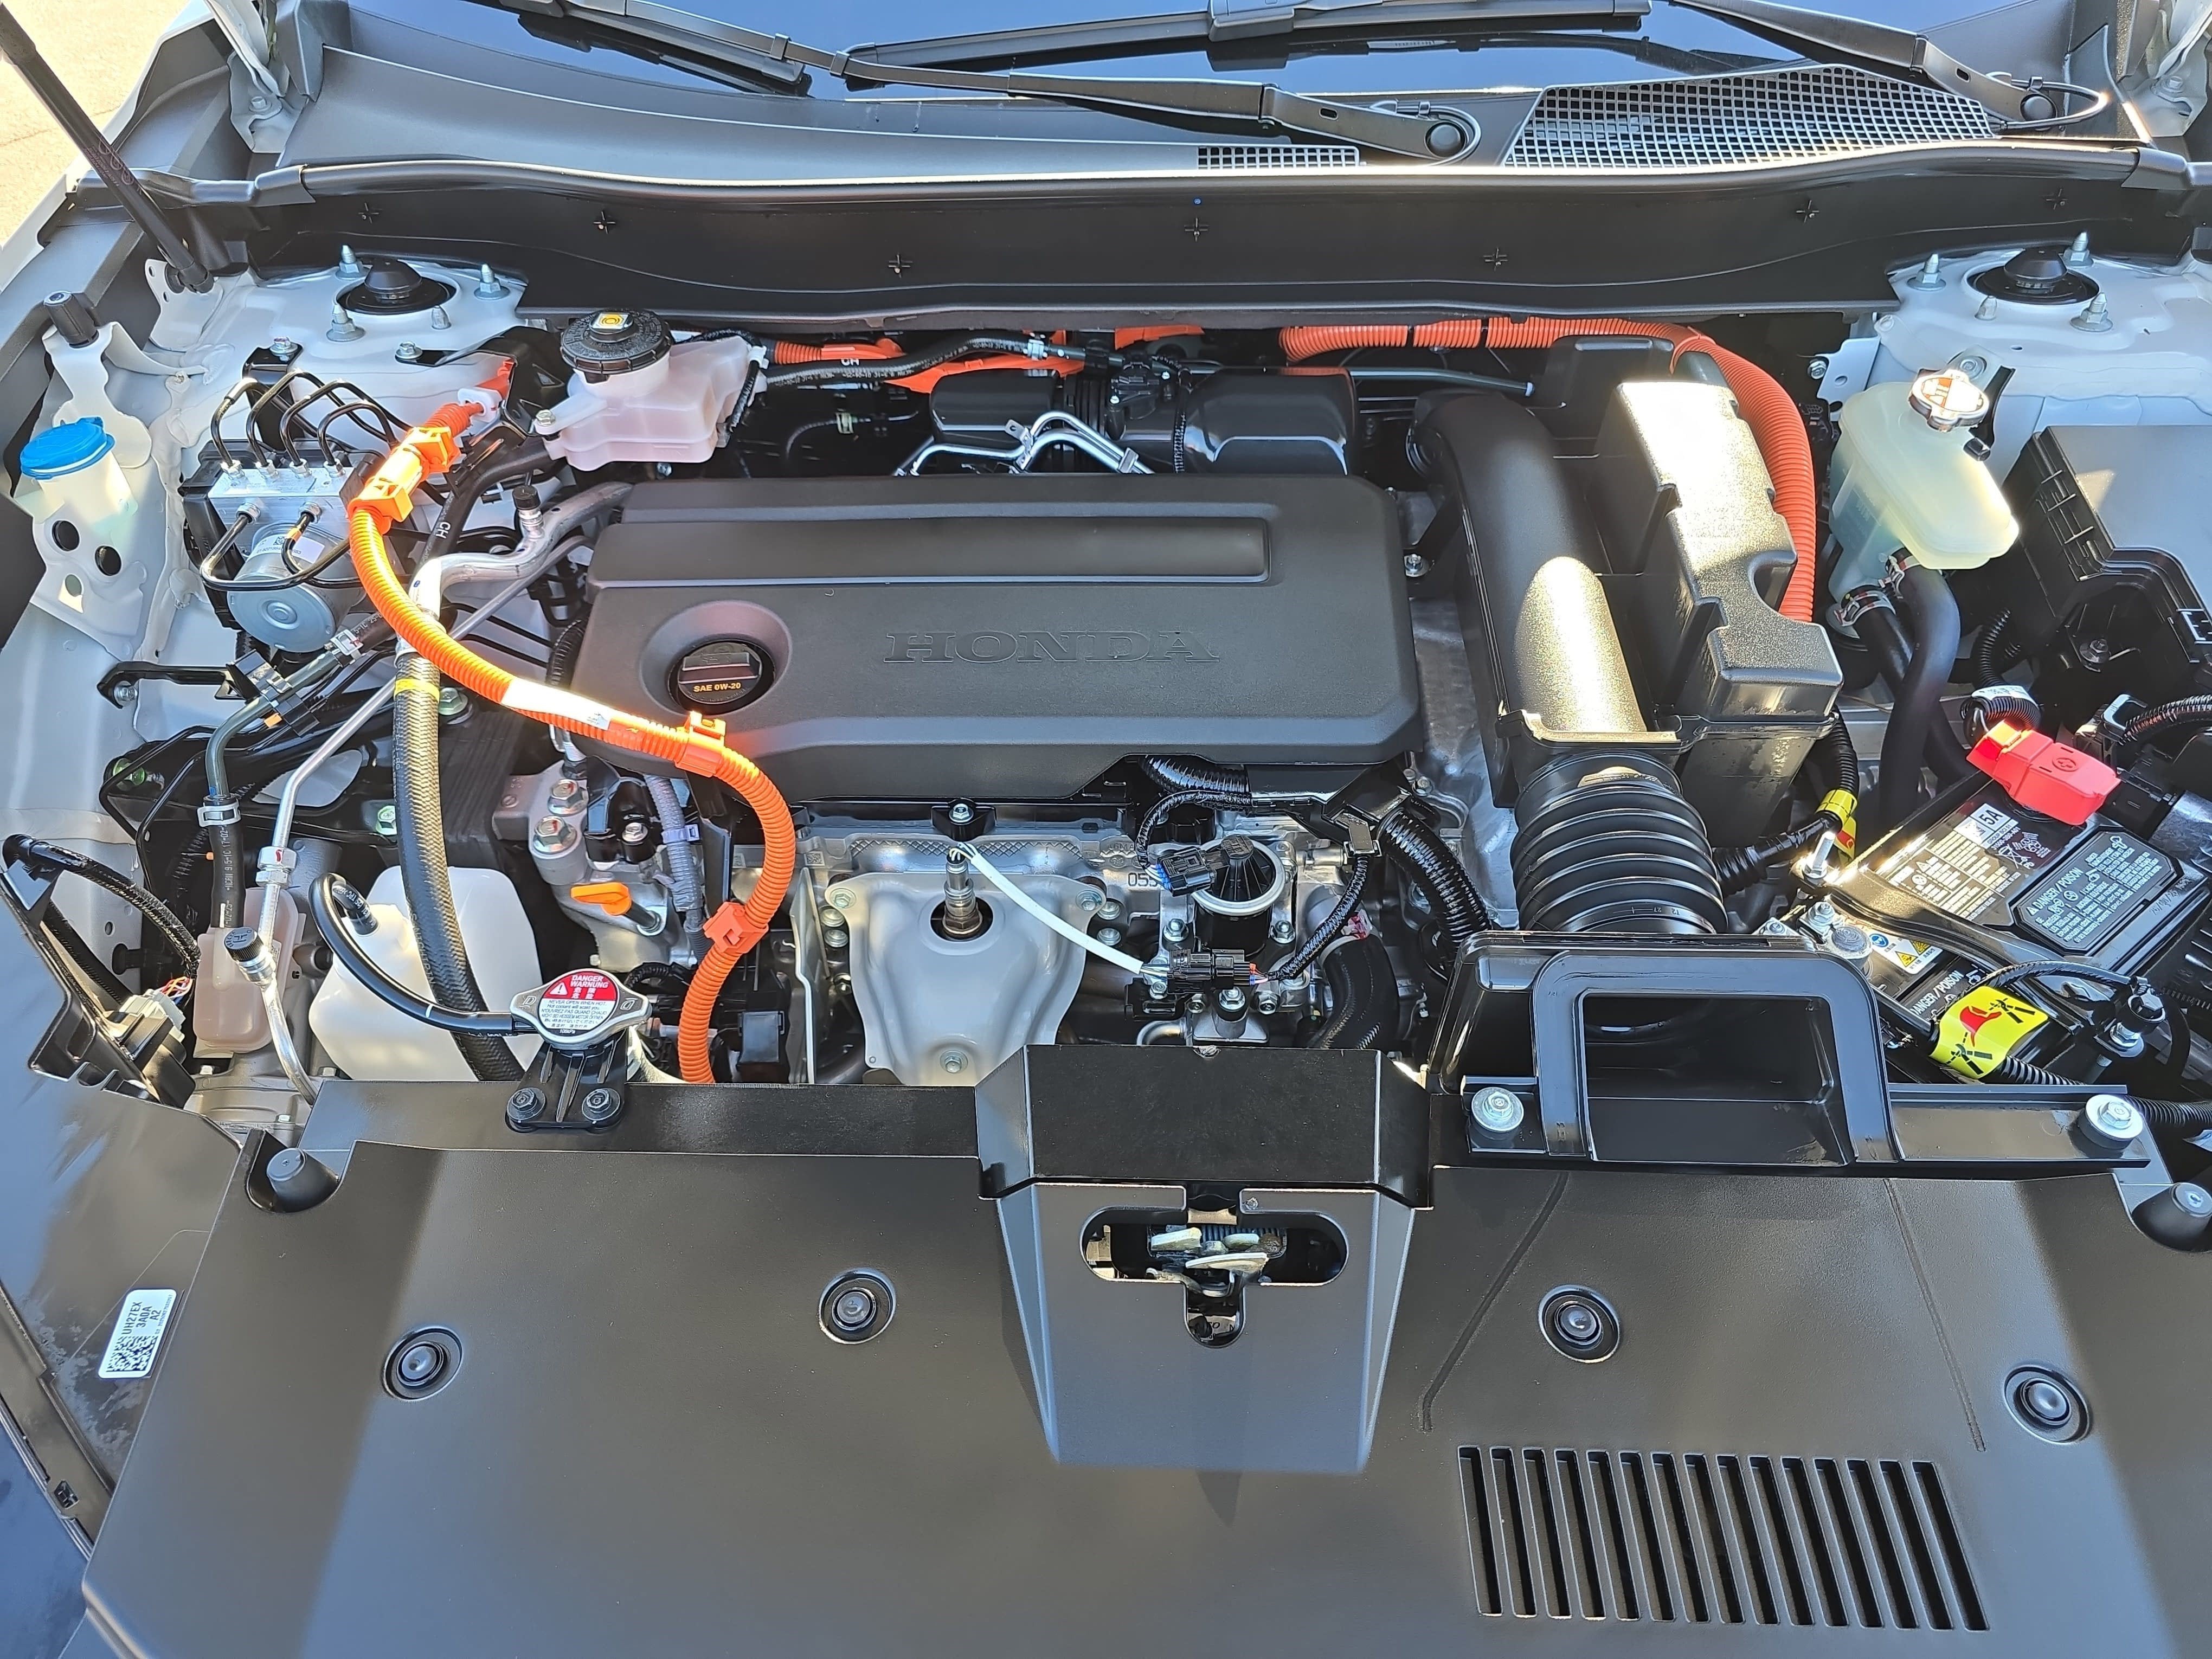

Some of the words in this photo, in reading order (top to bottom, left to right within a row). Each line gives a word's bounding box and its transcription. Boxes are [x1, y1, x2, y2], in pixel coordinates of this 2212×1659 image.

[436, 522, 451, 538] CH
[883, 631, 1220, 663] HONDA
[693, 684, 712, 692] SAE
[1979, 810, 2003, 825] 5A
[121, 1302, 143, 1334] UH27EX
[150, 1310, 162, 1320] A2
